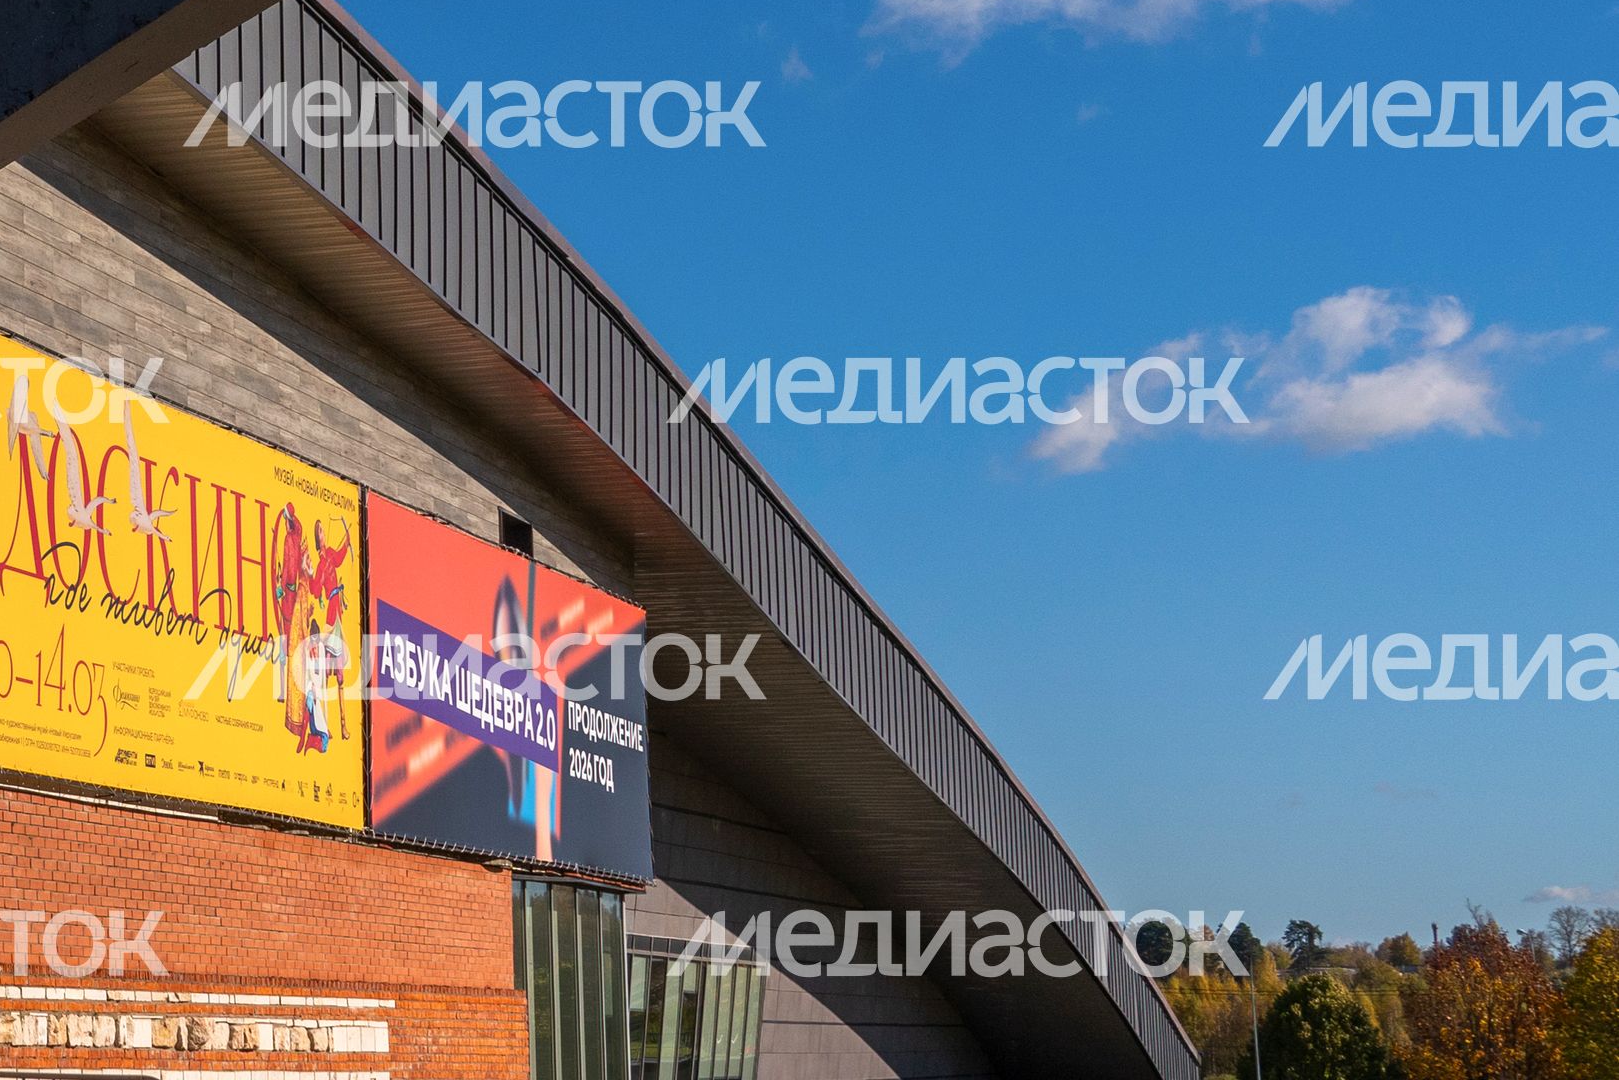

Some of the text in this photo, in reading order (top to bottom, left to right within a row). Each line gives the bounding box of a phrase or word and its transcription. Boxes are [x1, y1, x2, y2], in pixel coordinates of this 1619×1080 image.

[274, 466, 295, 488] МУЗЕЙ
[380, 630, 556, 752] АЗБУКА ШЕДЕВРА 2.0
[567, 701, 644, 753] ПРОДОЛЖЕНИЕ
[568, 747, 615, 794] 2026 ГОД
